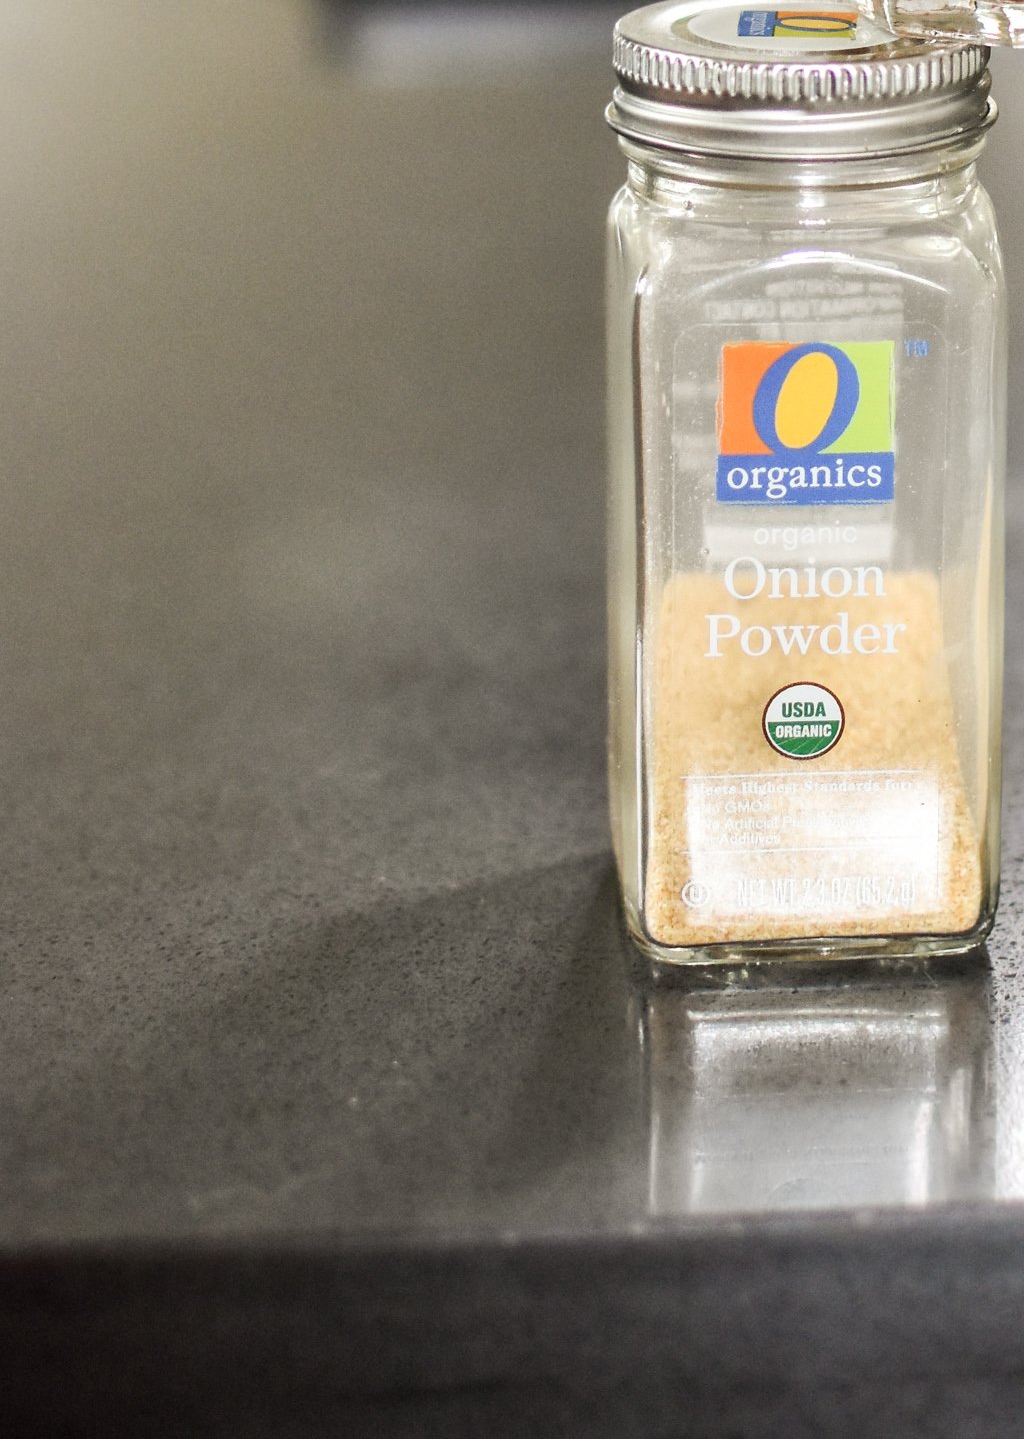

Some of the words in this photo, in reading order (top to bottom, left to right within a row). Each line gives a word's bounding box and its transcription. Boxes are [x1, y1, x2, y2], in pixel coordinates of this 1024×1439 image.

[727, 459, 882, 498] organics
[753, 520, 858, 550] organic
[723, 556, 887, 601] Onion
[703, 612, 907, 659] Powder
[781, 702, 826, 718] USDA
[775, 725, 832, 739] ORGANIC
